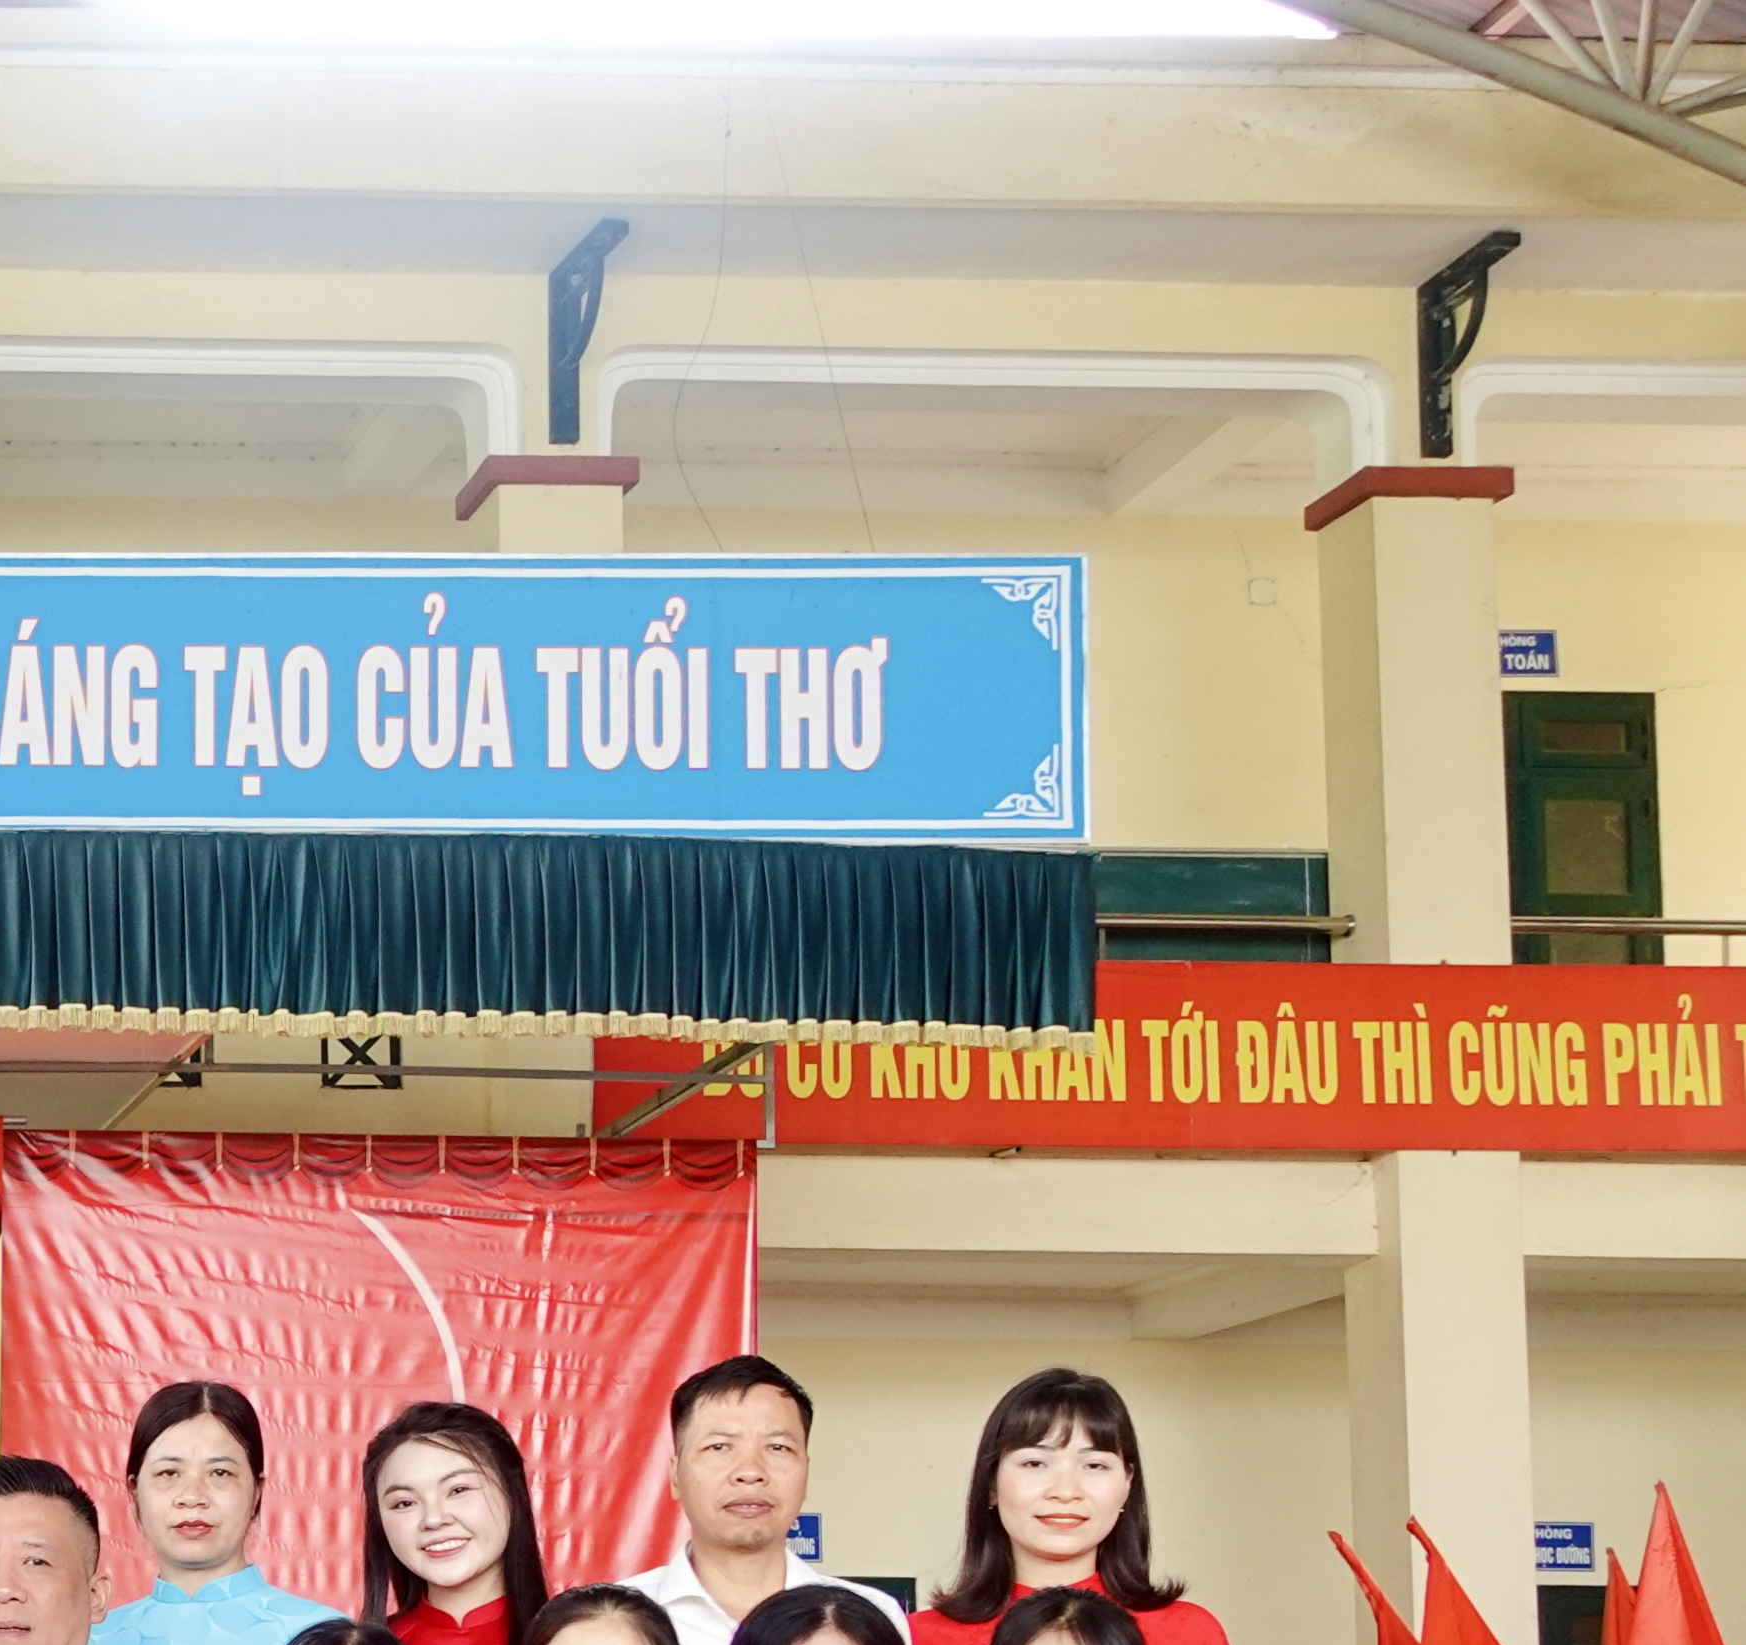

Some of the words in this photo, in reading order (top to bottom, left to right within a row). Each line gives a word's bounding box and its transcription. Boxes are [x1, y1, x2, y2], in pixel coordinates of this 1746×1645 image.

[183, 644, 329, 796] TẠO
[356, 591, 514, 770] CỦA
[536, 595, 710, 771] TUỔI
[734, 636, 888, 771] THƠ
[1504, 649, 1550, 670] TOÁN
[1141, 1001, 1222, 1103] TỚI
[1235, 1001, 1339, 1105] ĐÂU
[1352, 1002, 1433, 1105] THÌ
[1448, 1004, 1589, 1107] CŨNG
[1602, 993, 1723, 1107] PHẢI
